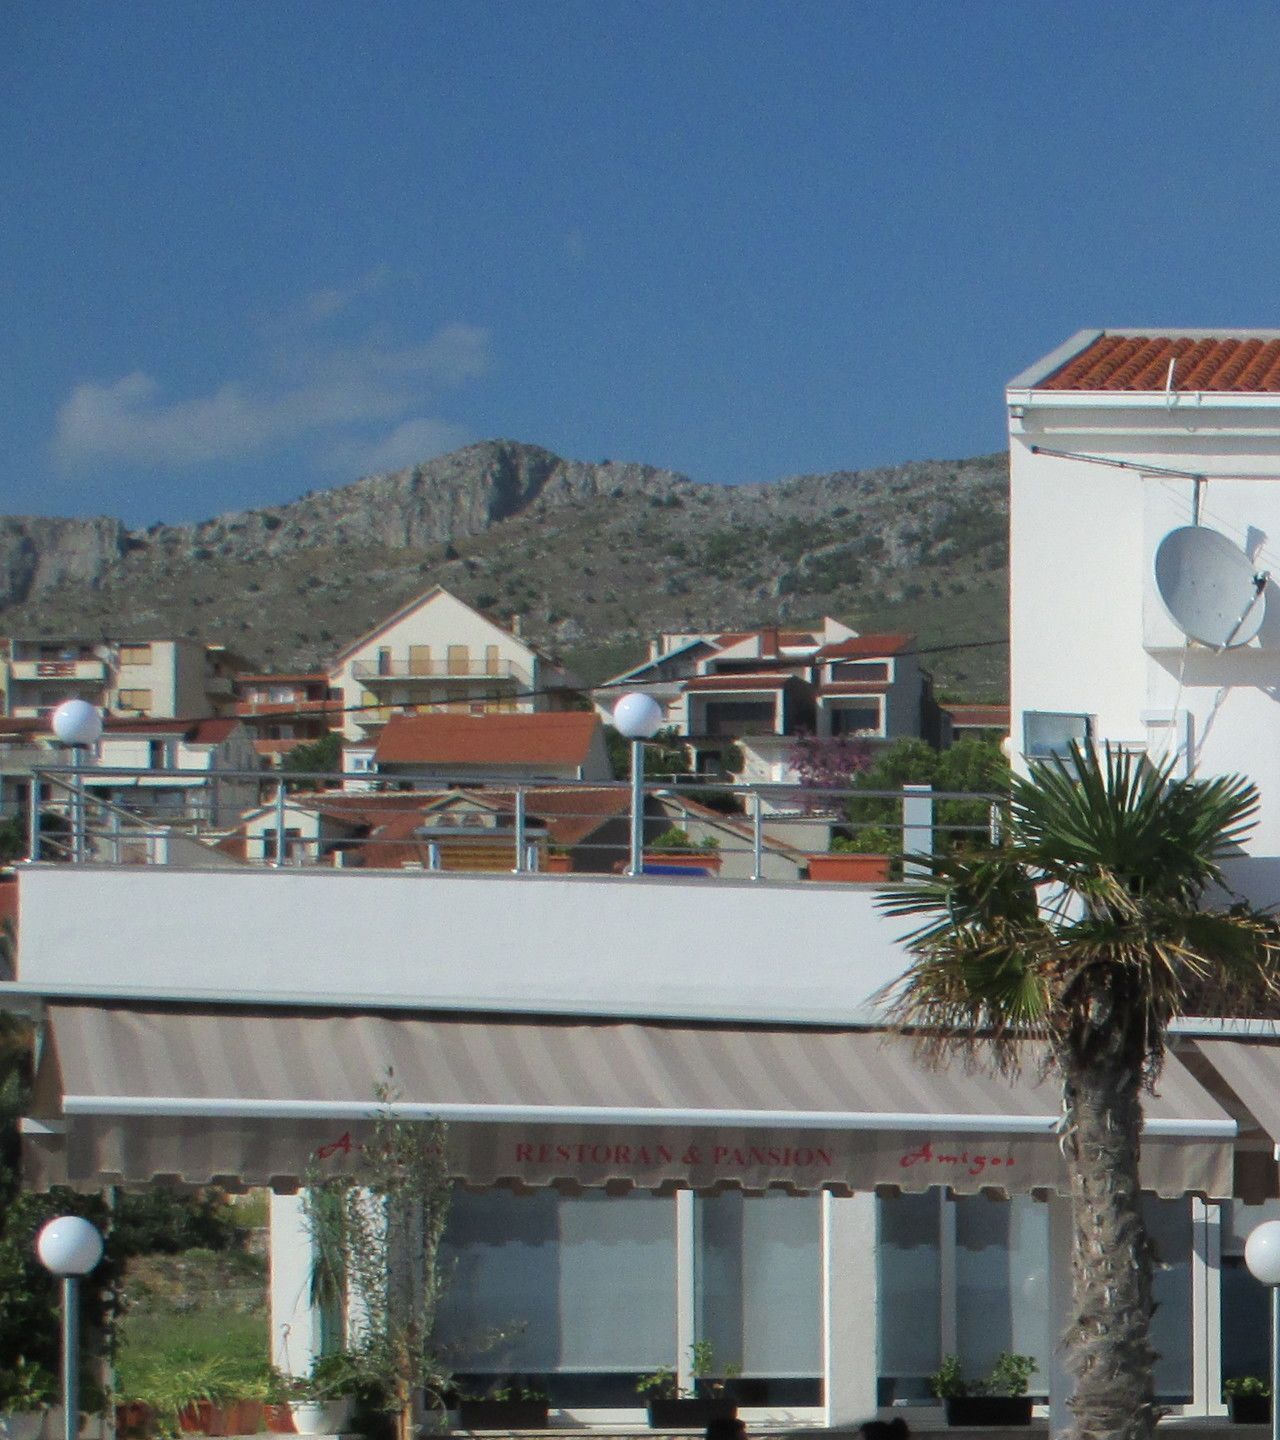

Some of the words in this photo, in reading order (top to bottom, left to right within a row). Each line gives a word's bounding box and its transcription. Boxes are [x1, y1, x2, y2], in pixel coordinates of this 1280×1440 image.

[515, 1142, 673, 1165] RESTORAN
[681, 1146, 699, 1165] &
[711, 1146, 833, 1168] PANSION
[900, 1141, 1016, 1176] Amigos
